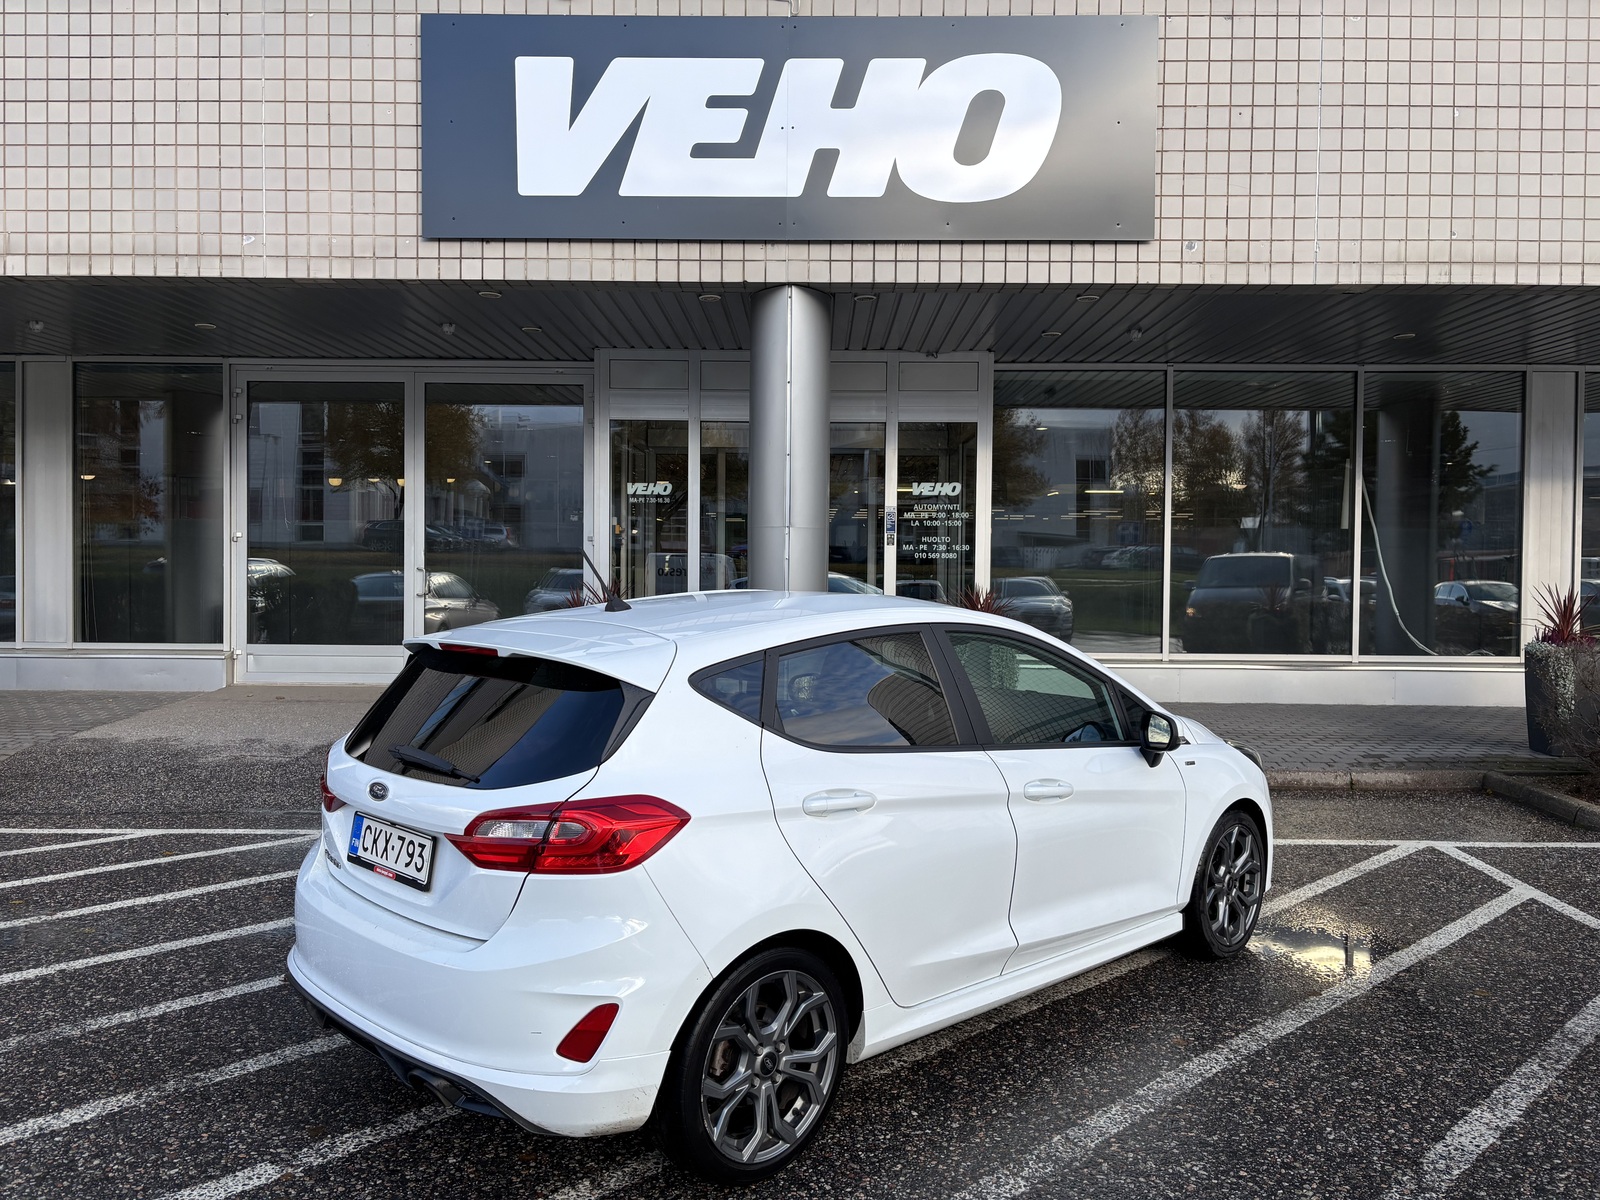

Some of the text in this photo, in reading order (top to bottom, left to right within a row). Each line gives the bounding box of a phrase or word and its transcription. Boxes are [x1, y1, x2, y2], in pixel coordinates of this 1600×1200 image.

[515, 53, 1062, 203] VEHO
[627, 482, 672, 496] VEHO
[912, 482, 961, 496] VEHO
